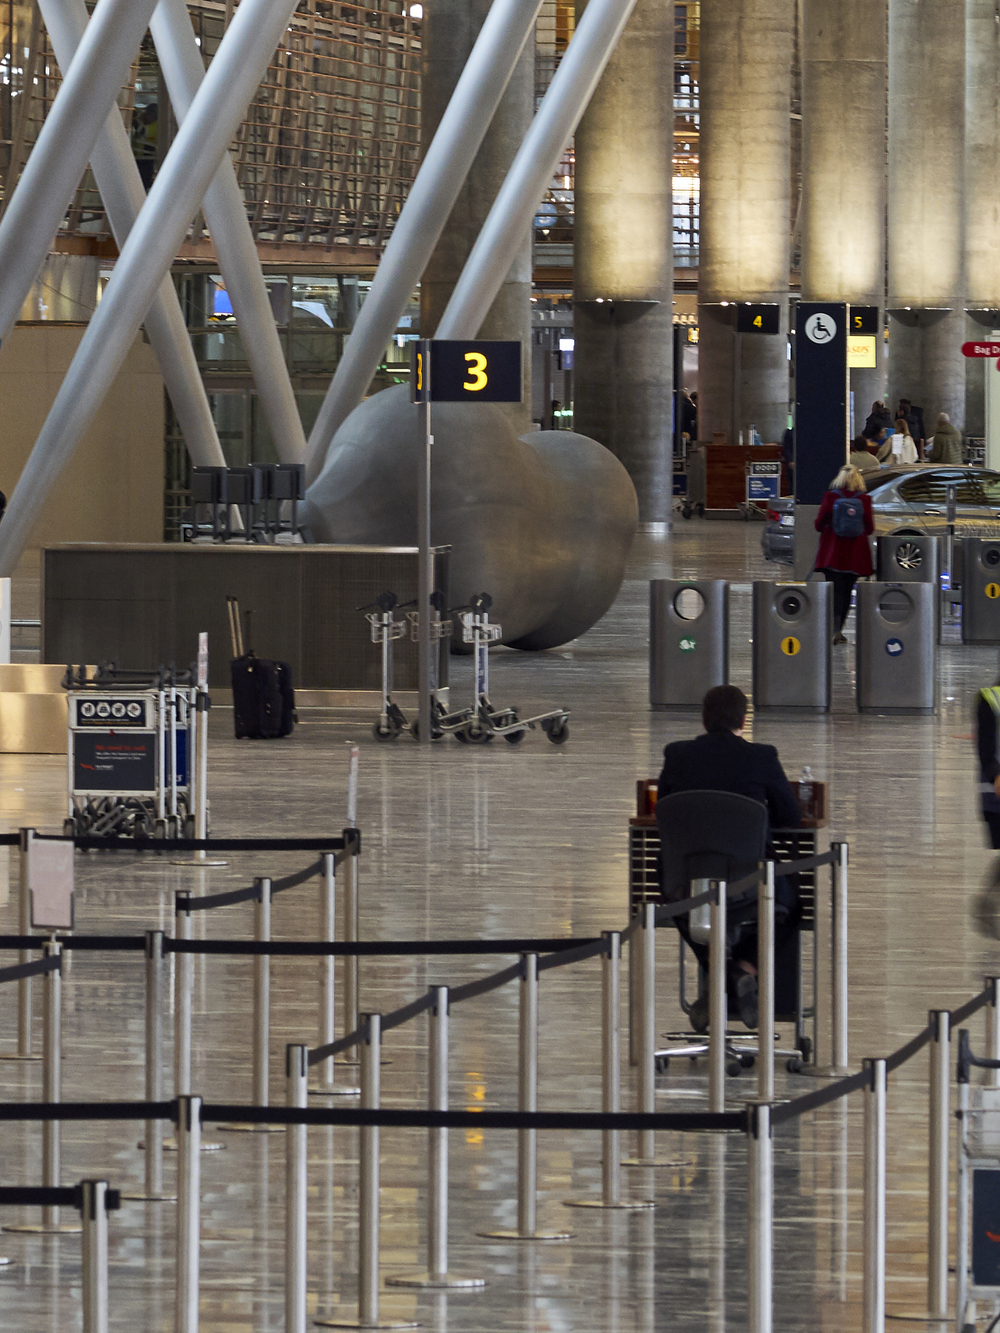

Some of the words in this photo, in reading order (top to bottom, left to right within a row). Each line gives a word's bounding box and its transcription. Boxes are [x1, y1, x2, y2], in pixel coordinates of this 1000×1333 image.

[752, 315, 763, 328] 4
[853, 316, 863, 328] 5
[974, 345, 991, 356] Bag
[417, 353, 423, 390] 3
[463, 352, 488, 391] 3
